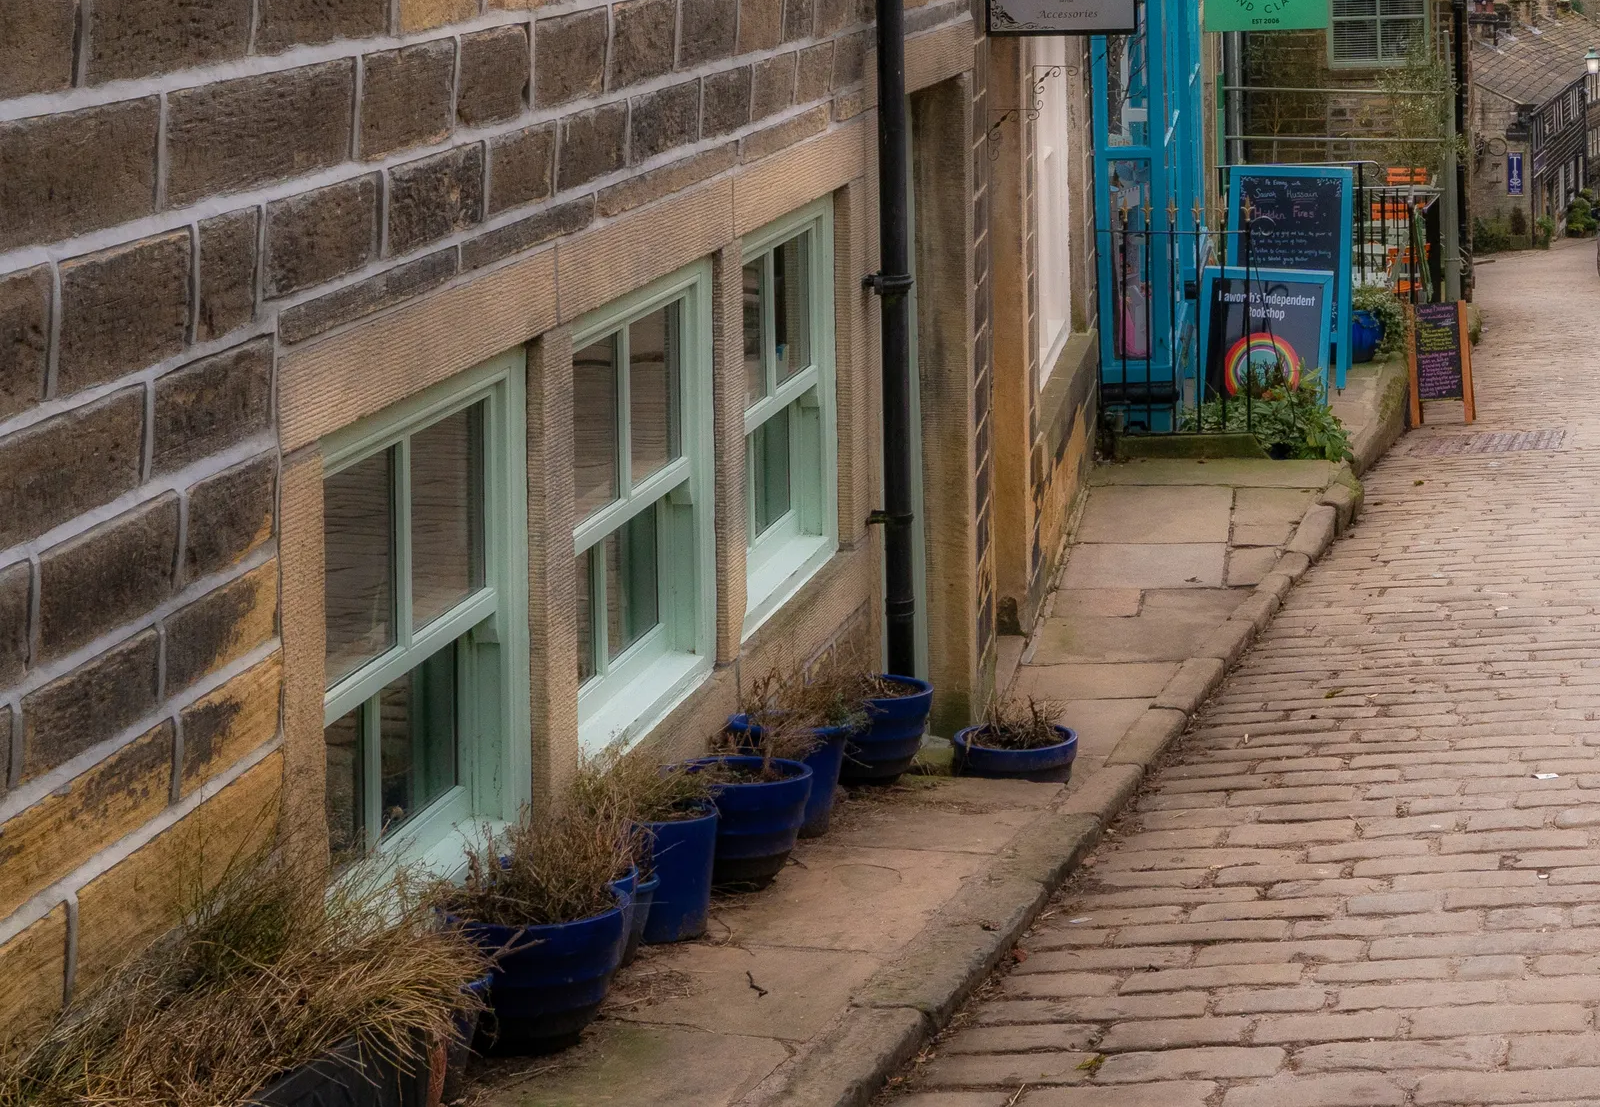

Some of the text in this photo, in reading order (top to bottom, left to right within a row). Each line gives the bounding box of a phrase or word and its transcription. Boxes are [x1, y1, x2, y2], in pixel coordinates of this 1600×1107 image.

[1036, 9, 1098, 19] Accessories
[1286, 189, 1319, 198] Hussain
[1254, 205, 1315, 219] Hidden Fires
[1218, 290, 1316, 307] aworh's Independent
